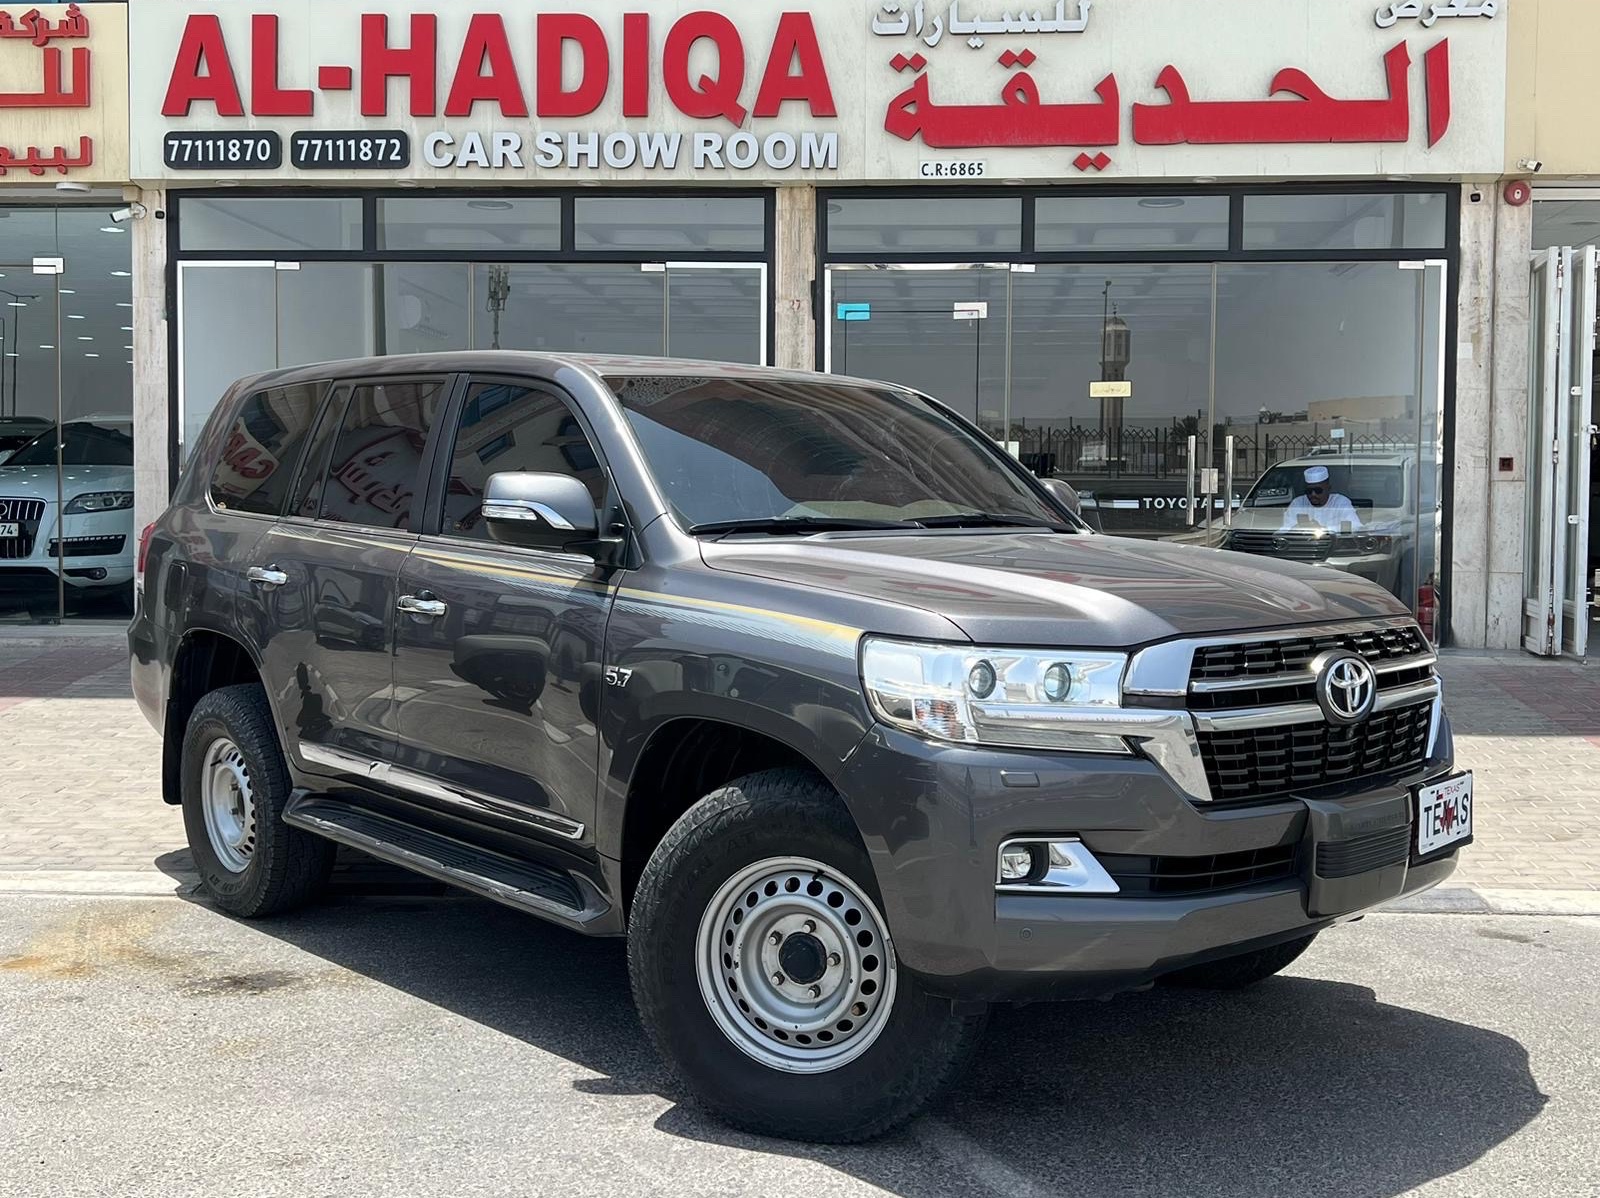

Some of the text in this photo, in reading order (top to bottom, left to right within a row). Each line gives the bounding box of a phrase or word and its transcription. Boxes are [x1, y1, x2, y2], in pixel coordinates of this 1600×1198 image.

[872, 0, 1092, 48] للسيارات
[161, 11, 838, 128] AL-HADIQA
[884, 38, 1450, 171] الحديقة
[168, 139, 271, 162] 77111870
[297, 138, 401, 162] 77111872
[423, 131, 839, 170] CAR SHOW ROOM
[921, 162, 984, 177] C.R:6865
[605, 665, 633, 688] 5.7
[1444, 783, 1460, 796] TEXAS
[1423, 793, 1469, 839] TEXAS
